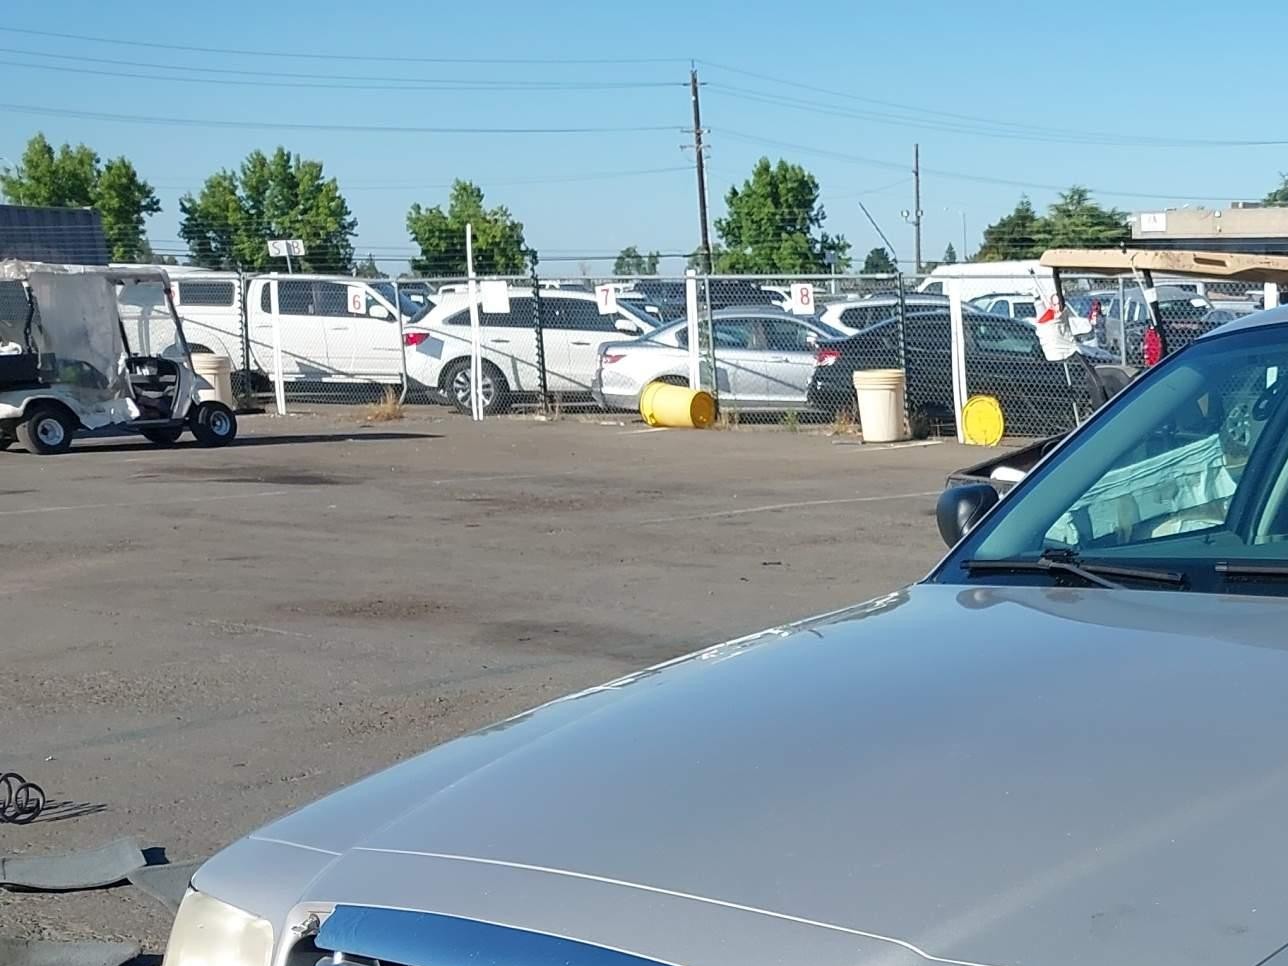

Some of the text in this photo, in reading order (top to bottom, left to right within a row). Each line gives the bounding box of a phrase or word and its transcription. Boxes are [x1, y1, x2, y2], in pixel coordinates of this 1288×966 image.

[352, 294, 361, 311] 6
[600, 287, 610, 306] 7
[800, 287, 810, 306] 8
